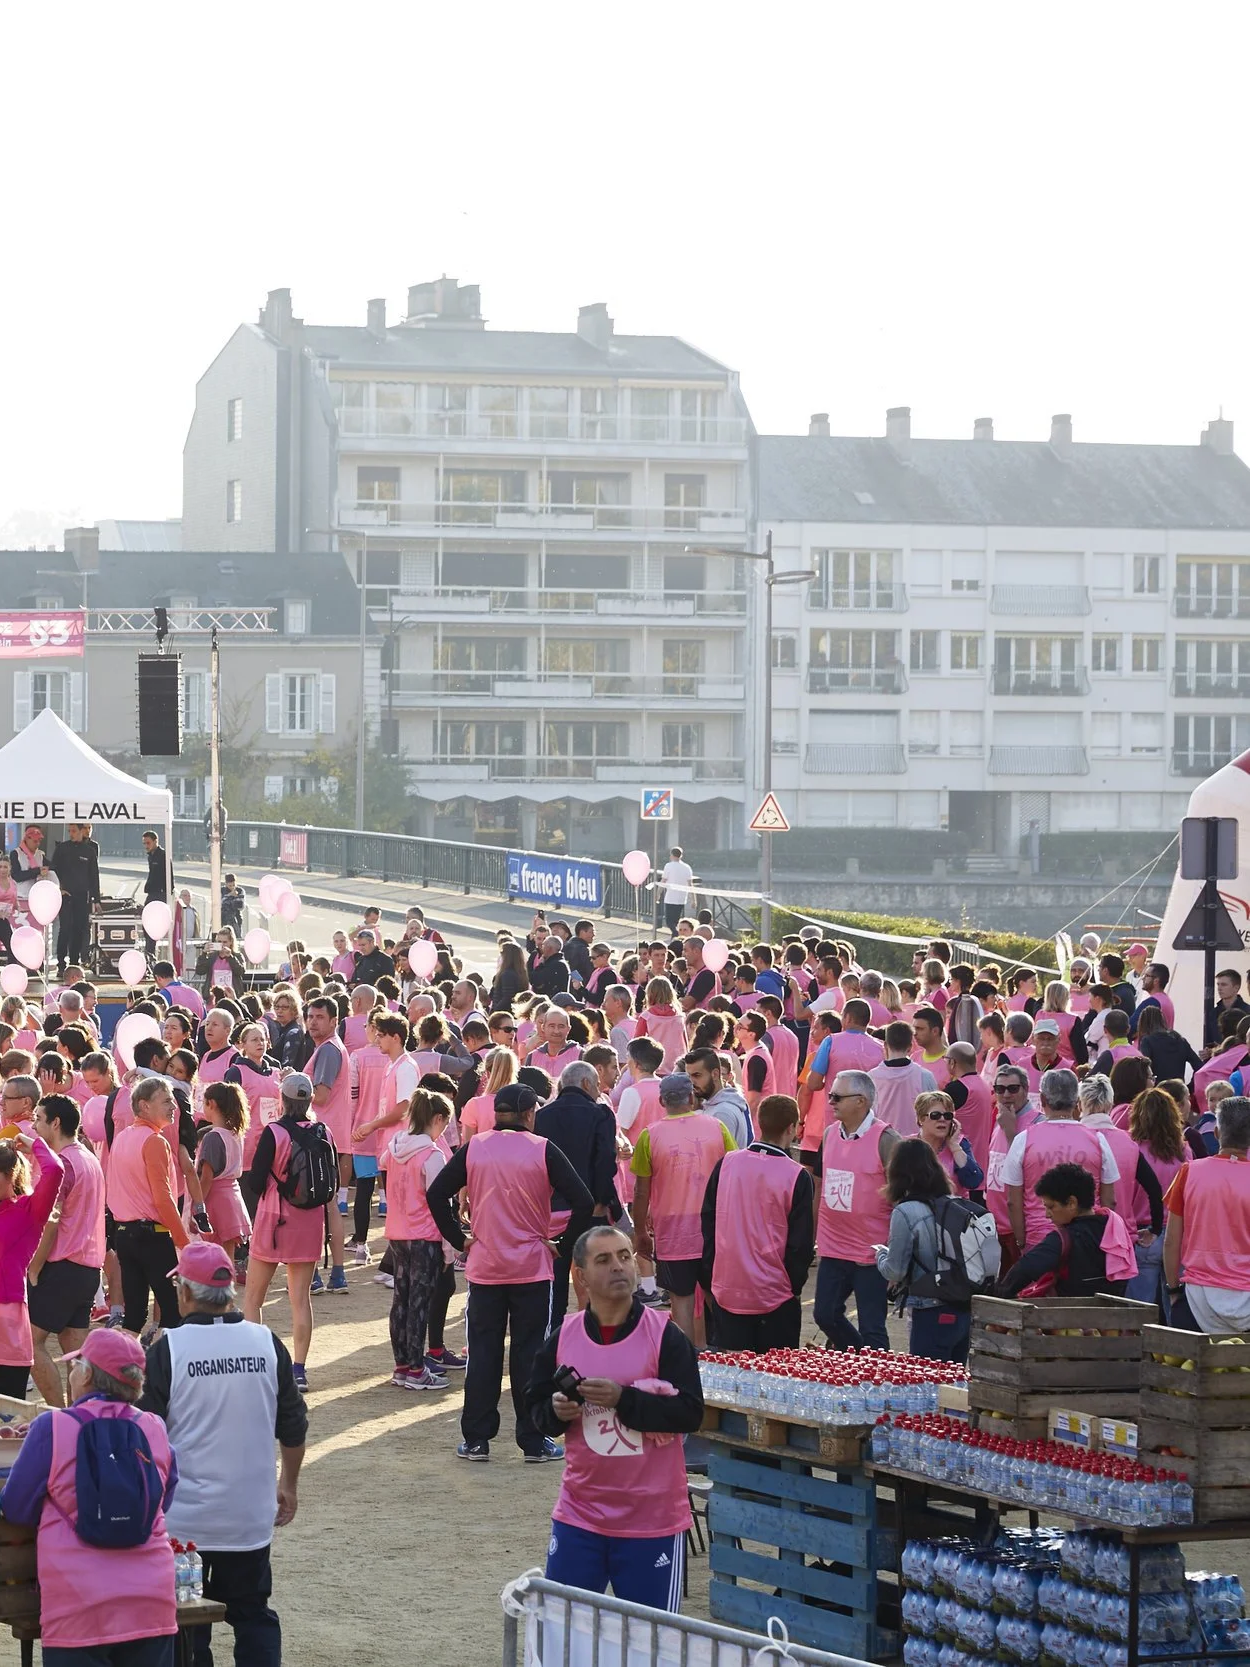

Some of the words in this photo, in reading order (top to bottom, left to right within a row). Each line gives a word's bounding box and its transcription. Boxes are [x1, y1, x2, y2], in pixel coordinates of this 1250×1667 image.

[33, 801, 65, 820] DE
[74, 802, 146, 820] LAVAL
[520, 862, 561, 898] france
[565, 868, 598, 902] bleu
[187, 1356, 267, 1378] ORGANISATEUR
